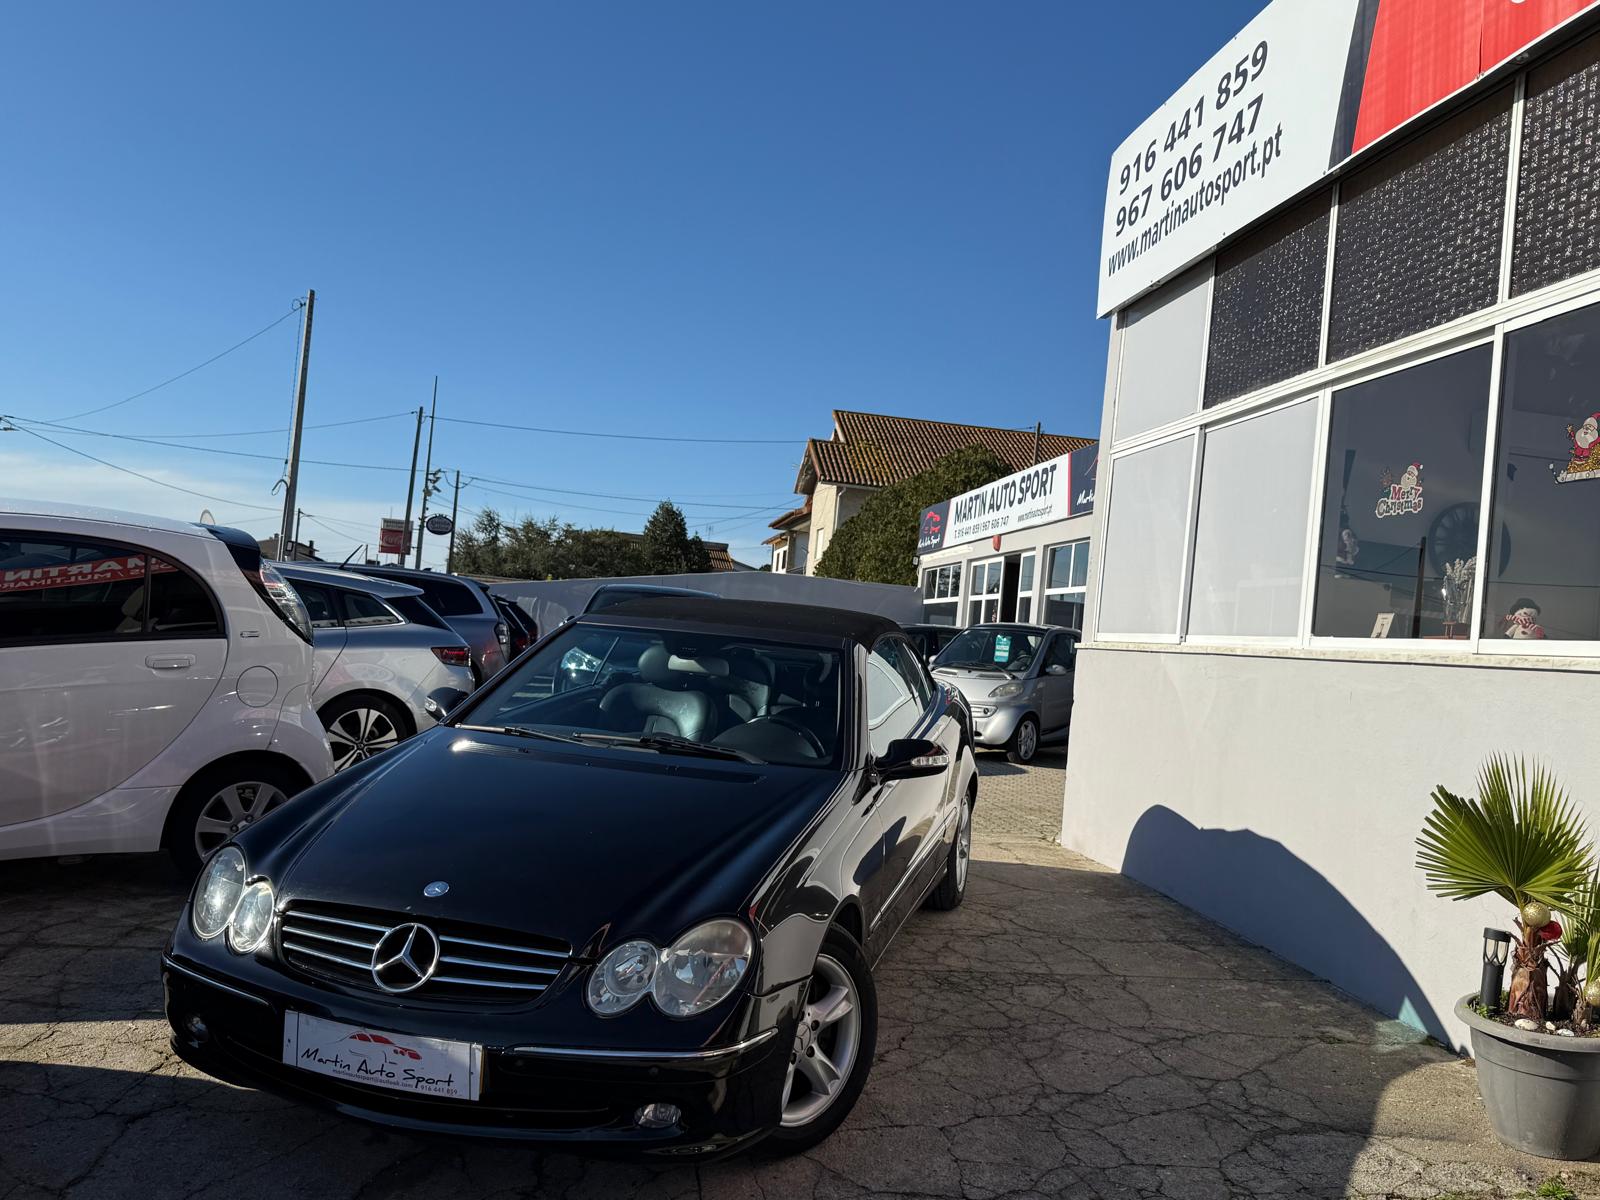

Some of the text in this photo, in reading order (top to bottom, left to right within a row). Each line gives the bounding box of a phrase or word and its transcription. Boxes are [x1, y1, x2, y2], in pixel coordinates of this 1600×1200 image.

[1120, 40, 1268, 195] 916 441 859
[1116, 93, 1264, 237] 967 606 747
[1108, 121, 1283, 277] www.martinautosport.pt
[954, 464, 1057, 525] MARTIN AUTO SPORT
[1376, 498, 1424, 518] Christmas
[1391, 484, 1422, 501] Merry
[301, 1047, 454, 1089] Martin Auto Sport
